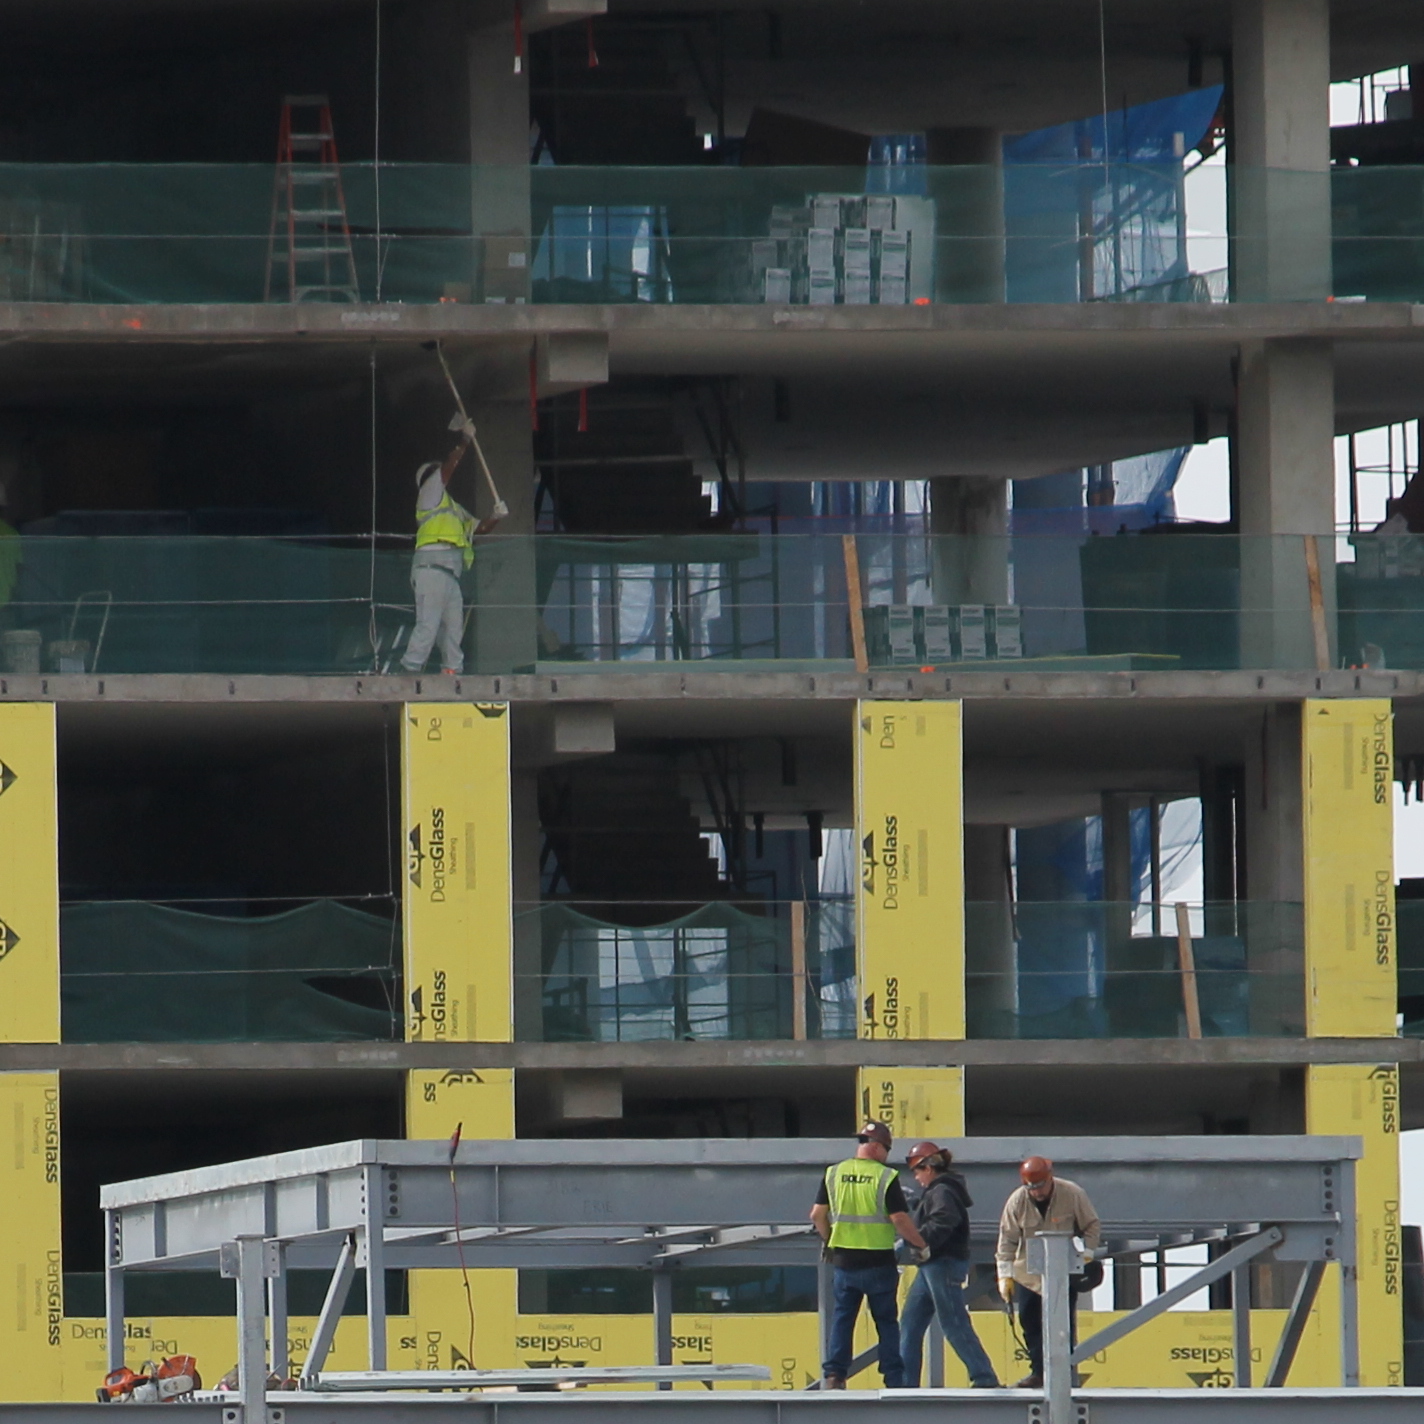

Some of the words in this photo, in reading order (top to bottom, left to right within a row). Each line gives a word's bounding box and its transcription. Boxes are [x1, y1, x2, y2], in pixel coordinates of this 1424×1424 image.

[427, 717, 442, 742] De
[880, 715, 895, 750] Den
[429, 805, 446, 903] DensGlass
[448, 837, 457, 875] Sheathing
[882, 814, 899, 911] DensGlass
[902, 843, 911, 882] Sheathing
[1375, 869, 1393, 966] DensGlass
[884, 976, 898, 1039] sGlass
[1382, 1078, 1398, 1134] Glass
[44, 1088, 60, 1184] DensGlass
[841, 1174, 874, 1184] BOLDT
[1385, 1200, 1400, 1296] DensGlass
[47, 1250, 62, 1347] DensGlass
[516, 1336, 602, 1352] DensGlass
[780, 1357, 796, 1390] Den
